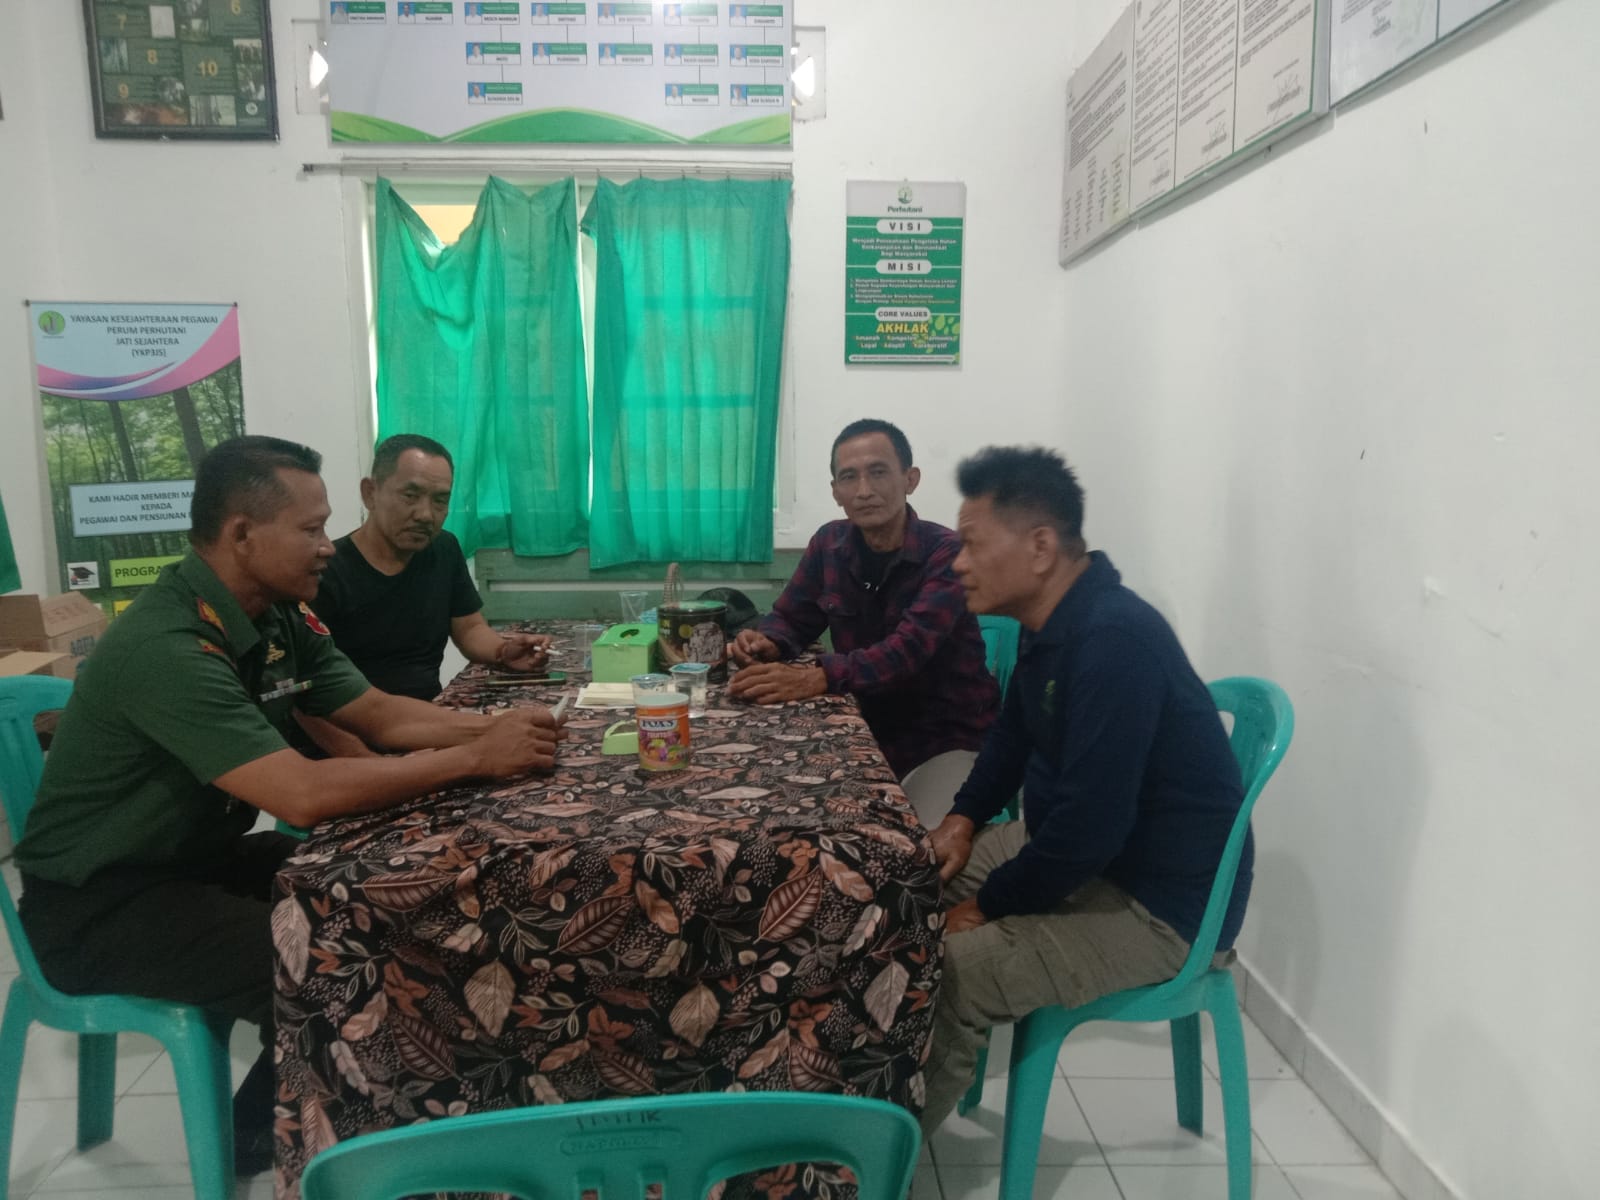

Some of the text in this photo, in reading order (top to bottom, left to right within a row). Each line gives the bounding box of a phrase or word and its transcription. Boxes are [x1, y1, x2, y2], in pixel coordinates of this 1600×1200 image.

[147, 49, 158, 65] 8
[198, 60, 218, 78] 10
[118, 83, 129, 99] 9
[887, 205, 923, 214] Perhutani
[889, 222, 921, 231] VISI
[887, 262, 921, 271] MISI
[70, 315, 218, 325] YAYASAN KESEJAHTERAAN PEGAWAI
[107, 326, 187, 335] PERUM PERHUTANI
[876, 322, 929, 334] AKHLAK
[116, 337, 180, 346] JATI SEJAHTERA
[88, 495, 112, 504] KAMI
[113, 494, 140, 503] HADIR
[141, 492, 180, 501] MEMBERI
[141, 502, 173, 511] KEPADA
[80, 516, 118, 525] PEGAWAI
[119, 514, 138, 523] DAN
[139, 512, 187, 521] PENSIUNAN
